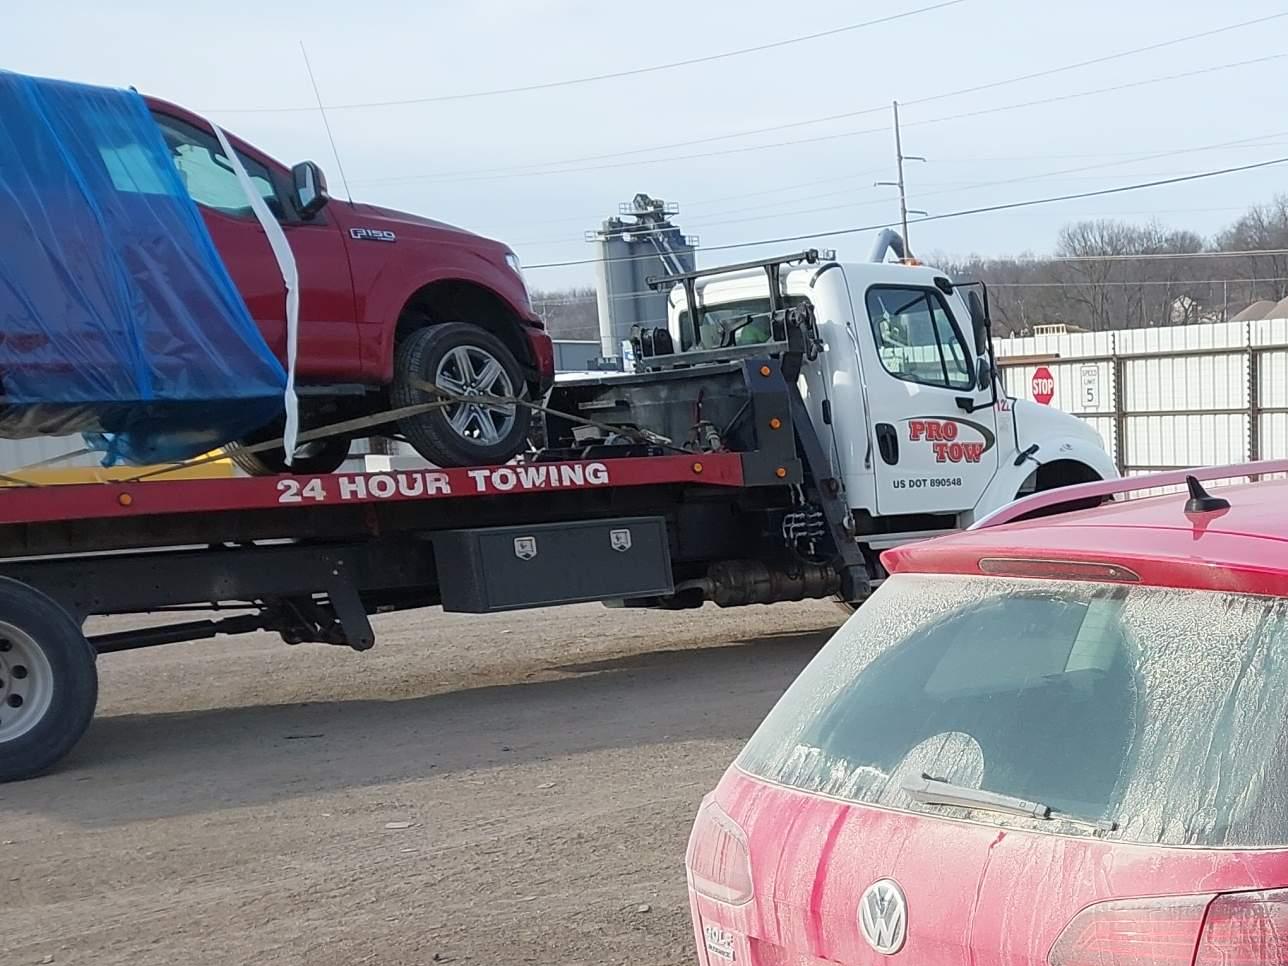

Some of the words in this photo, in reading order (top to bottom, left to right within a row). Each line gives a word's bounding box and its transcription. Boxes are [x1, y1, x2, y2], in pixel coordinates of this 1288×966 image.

[1032, 378, 1054, 395] STOP
[1086, 387, 1094, 402] 5
[908, 420, 958, 441] PRO
[933, 442, 983, 463] TOW
[277, 479, 326, 503] 24
[338, 472, 451, 500] HOUR
[467, 462, 609, 492] TOWING
[893, 479, 906, 488] US
[908, 479, 928, 488] DOT
[930, 477, 962, 487] 890548
